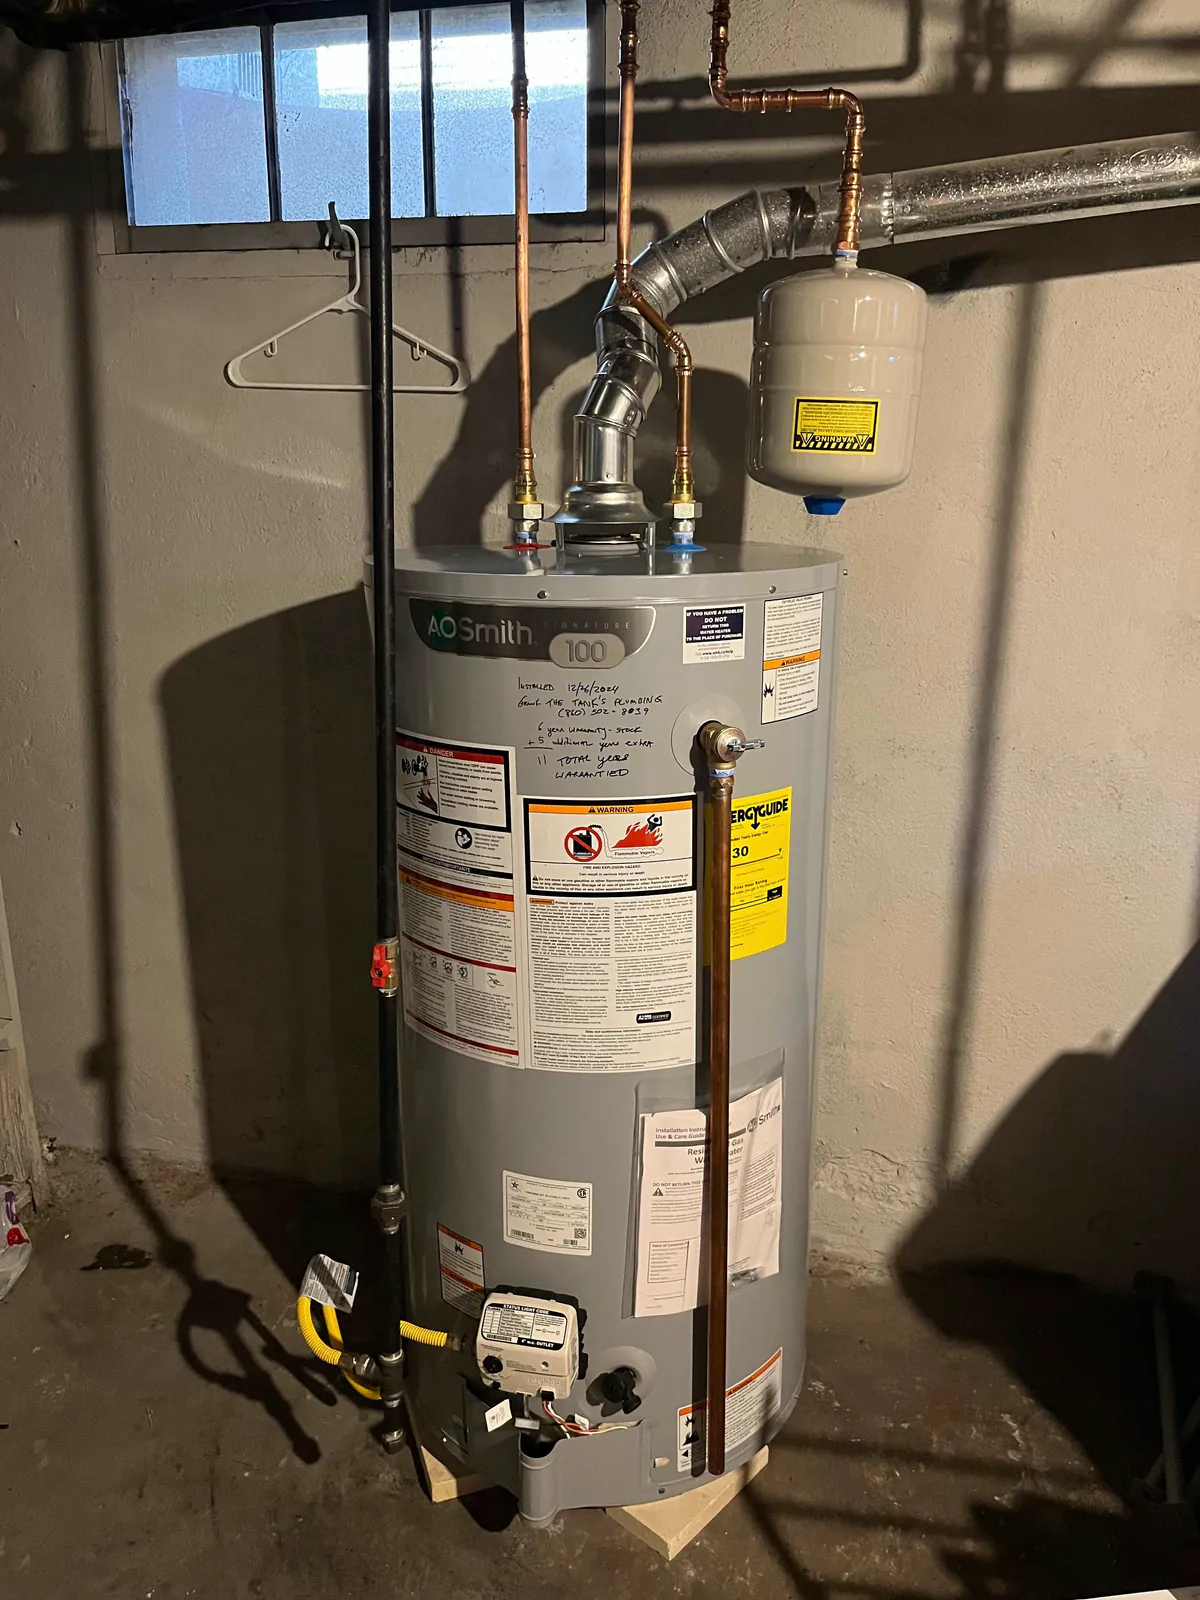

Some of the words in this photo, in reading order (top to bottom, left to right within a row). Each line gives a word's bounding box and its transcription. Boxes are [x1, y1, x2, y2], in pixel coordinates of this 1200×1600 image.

[815, 435, 855, 443] WARNING
[543, 621, 631, 629] SIGNATURE
[565, 639, 607, 663] 100
[785, 656, 805, 664] WARNING
[545, 699, 564, 707] THE
[571, 695, 607, 708] TANK'S
[614, 695, 663, 706] PLUMBING
[558, 708, 585, 718] (860)
[621, 707, 649, 716] 8039
[537, 721, 544, 731] 6
[538, 736, 544, 744] 5
[429, 747, 454, 758] DANGER
[537, 755, 547, 765] 11
[557, 755, 591, 767] TOTAL
[555, 768, 629, 779] WARRANTIED
[731, 797, 789, 824] ERGYGUIDE
[732, 846, 749, 859] 30
[731, 1138, 744, 1146] Gas
[729, 1146, 743, 1156] ater
